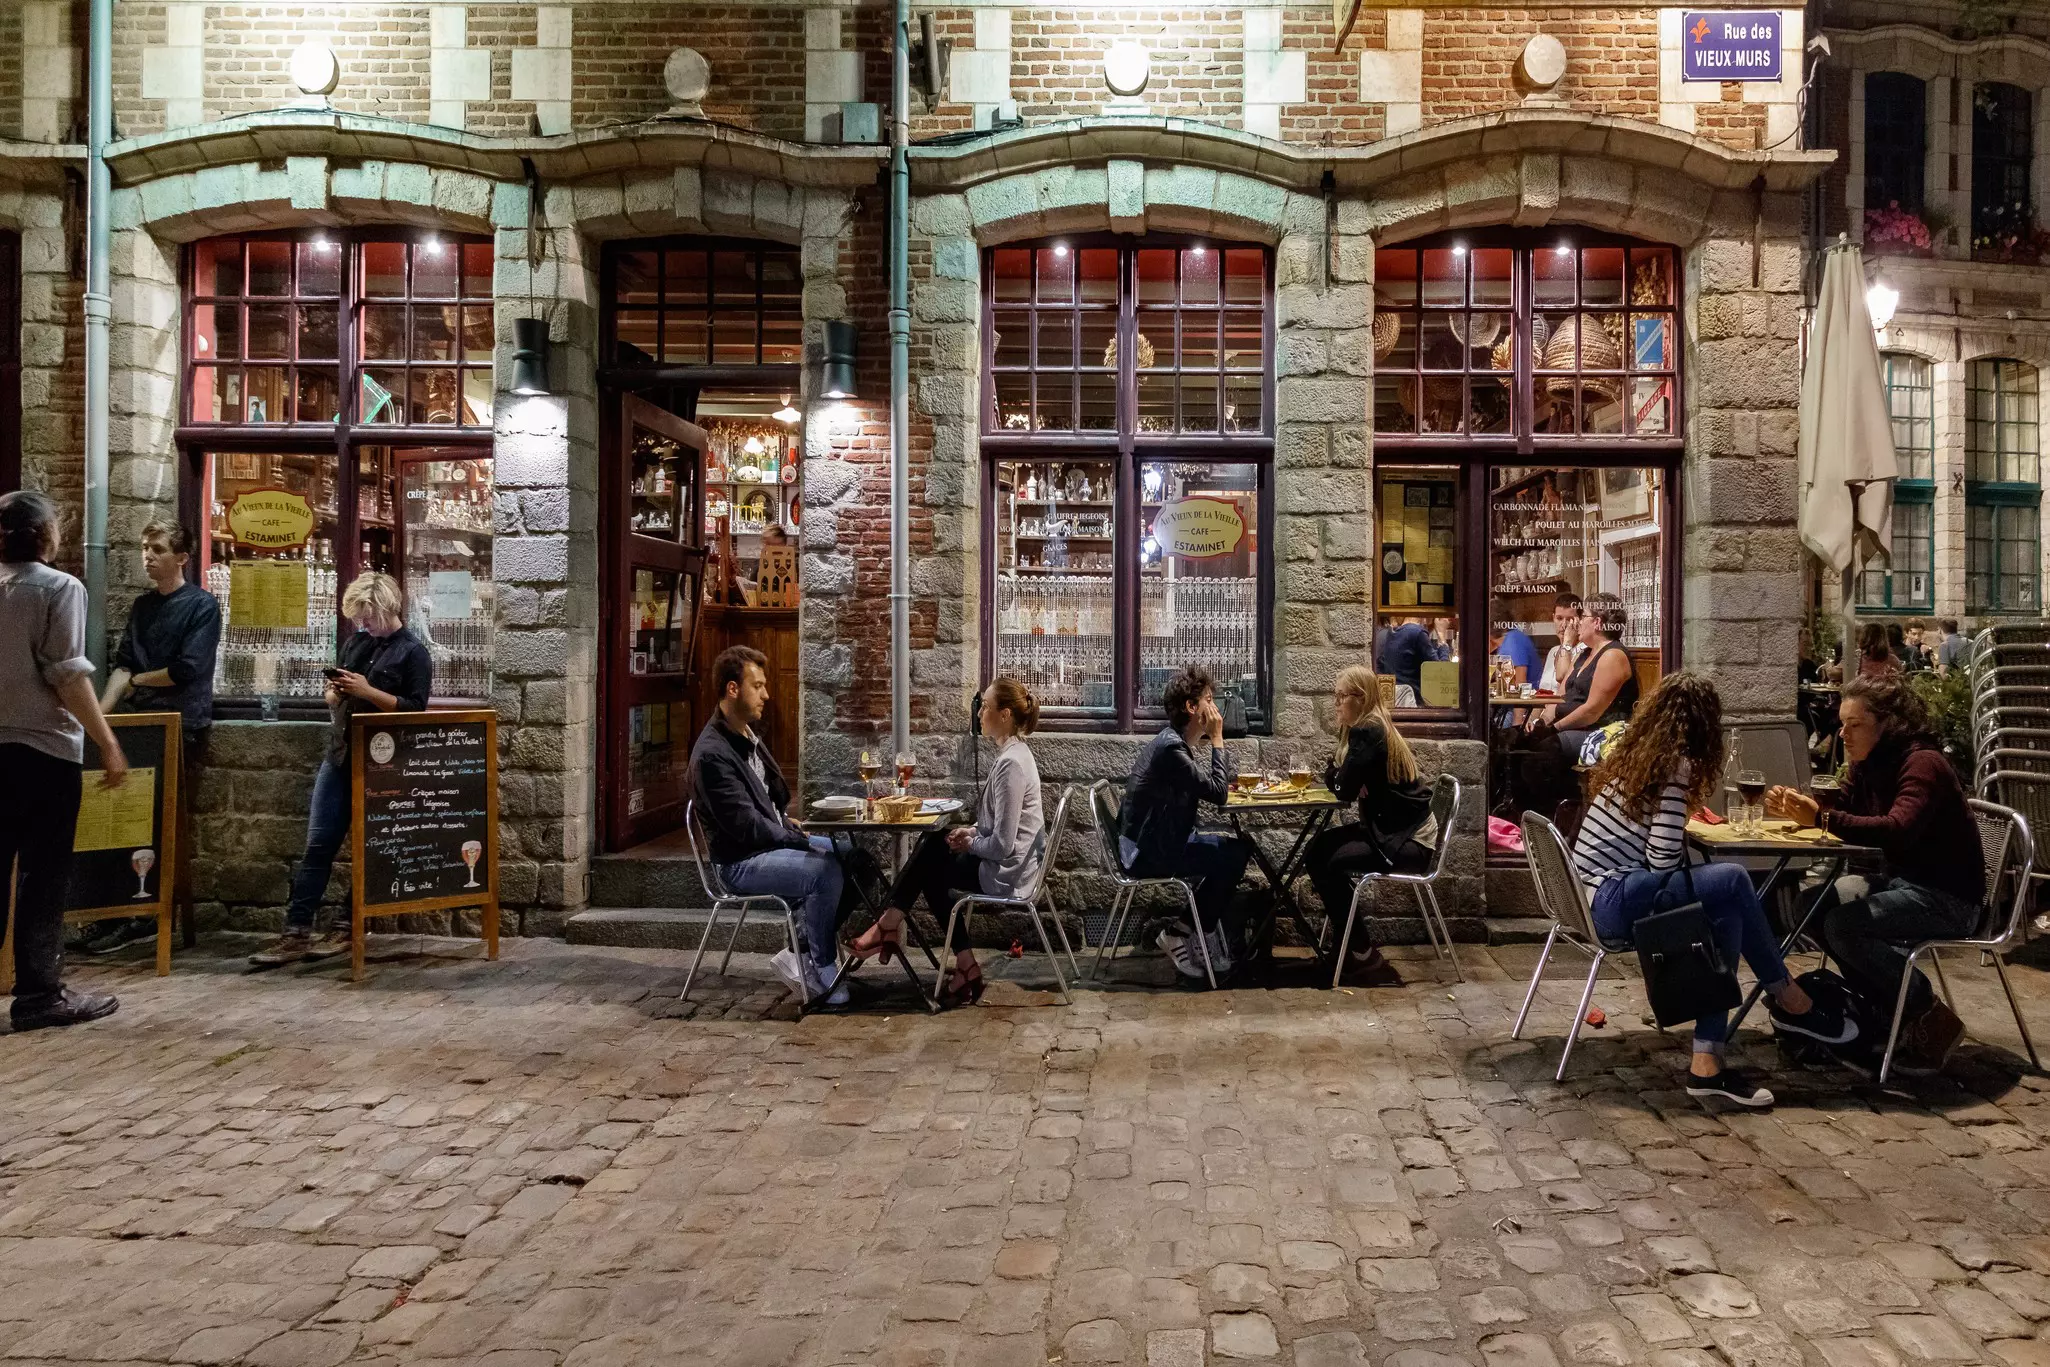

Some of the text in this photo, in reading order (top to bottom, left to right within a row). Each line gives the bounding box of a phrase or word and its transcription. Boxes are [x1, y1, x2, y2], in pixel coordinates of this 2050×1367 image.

[1724, 22, 1772, 40] Rue des
[1695, 50, 1771, 67] VIEUX MURS
[242, 502, 265, 514] VIEUX
[265, 502, 273, 510] DE
[275, 502, 284, 511] LA
[285, 502, 312, 520] VIEILLE
[1493, 503, 1550, 512] CARBONNADE
[1551, 503, 1595, 512] FLAMAN
[262, 519, 280, 527] CAFE
[1171, 511, 1194, 522] VIEUX
[1194, 511, 1203, 519] DE
[1204, 511, 1213, 519] LA
[1214, 510, 1241, 527] VIEILLE
[1535, 520, 1566, 529] POULET
[1568, 520, 1580, 529] AU
[1582, 520, 1625, 529] MAROILLES
[244, 530, 297, 544] ESTAMINET
[1190, 528, 1209, 536] CAFE
[1043, 543, 1068, 552] GLACES
[1174, 540, 1226, 553] ESTAMINET
[1493, 538, 1521, 547] WELCH
[1523, 538, 1535, 547] AU
[1536, 538, 1581, 547] MAROILLES
[1494, 583, 1557, 594] CRÊPE MAISON
[1570, 601, 1604, 610] GAUFRE
[1493, 621, 1527, 631] MOUSSE
[439, 728, 446, 738] le
[422, 758, 440, 767] chaud
[392, 825, 419, 836] plusieurs
[383, 846, 399, 858] Café
[402, 844, 433, 854] gourmand
[418, 881, 433, 890] vite
